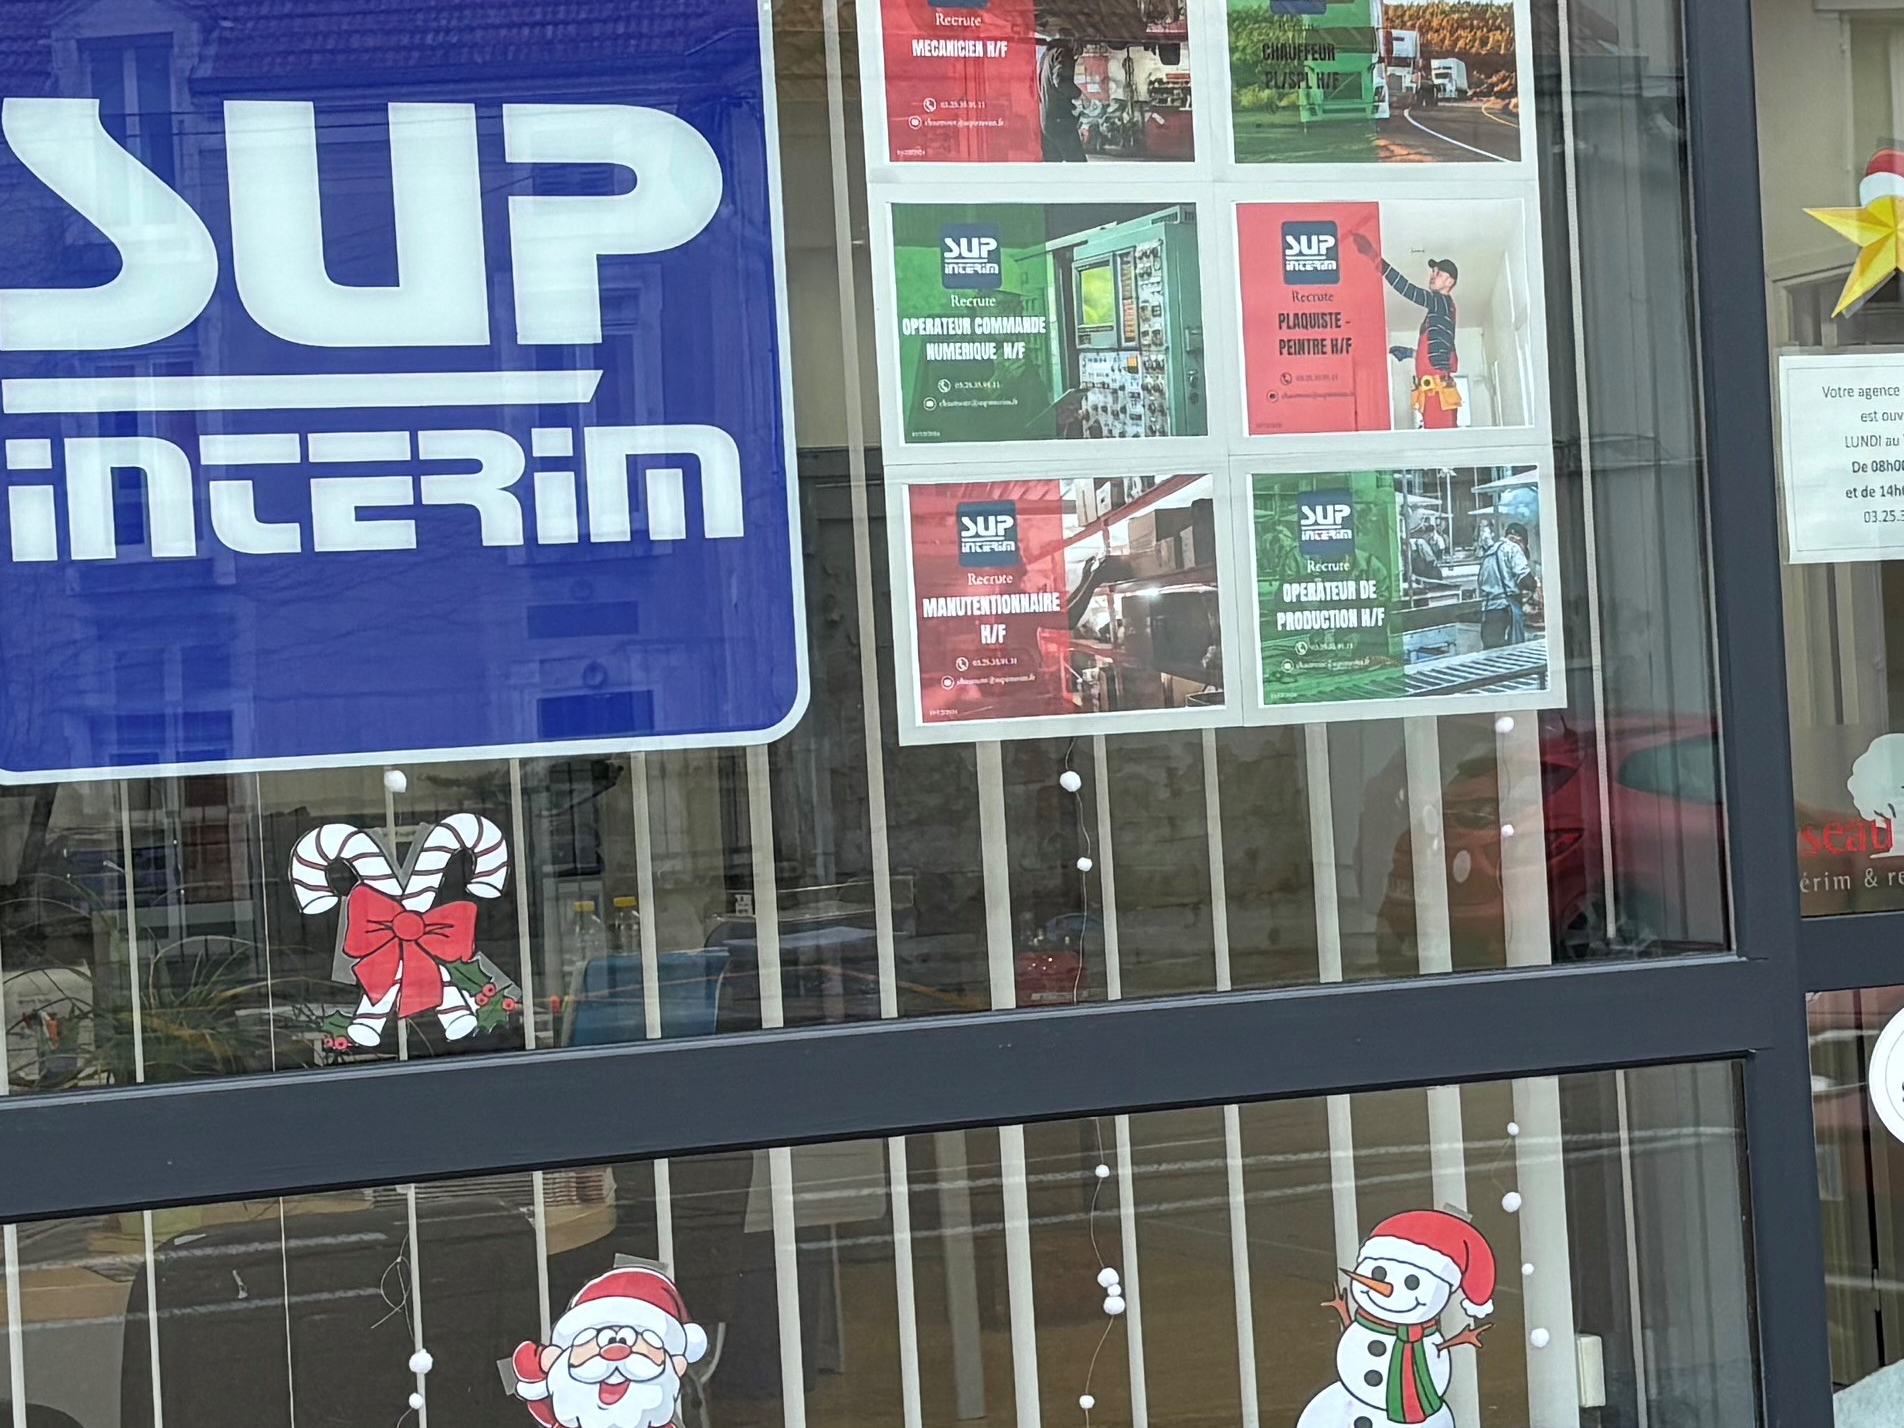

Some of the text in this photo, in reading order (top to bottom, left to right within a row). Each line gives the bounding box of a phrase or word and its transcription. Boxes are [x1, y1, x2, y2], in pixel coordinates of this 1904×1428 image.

[935, 13, 982, 26] Recrute
[912, 39, 1007, 57] MECANICIEN H/F
[1262, 42, 1336, 62] CHAUFFEUR
[1316, 72, 1340, 90] H/F
[944, 237, 998, 258] SUP
[1285, 235, 1336, 255] SUP
[951, 295, 996, 307] Recrute
[1292, 291, 1334, 303] Recrute
[902, 316, 1046, 335] OPERATEUR COMMANDE
[1278, 312, 1342, 330] PLAQUISTE
[926, 342, 1025, 360] NUMERIQUE H/F
[1279, 338, 1352, 356] PEINTRE H/F
[1821, 385, 1854, 399] Votre
[1858, 384, 1900, 400] agence
[1860, 410, 1878, 422] est
[1845, 435, 1881, 449] LUNDI
[1885, 437, 1900, 447] au
[1852, 460, 1868, 473] De
[1845, 487, 1859, 499] et
[1861, 484, 1876, 498] de
[1300, 504, 1351, 525] SUP
[961, 515, 1014, 537] SUP
[1307, 560, 1350, 572] Recrute
[968, 573, 1013, 585] Recrute
[1282, 580, 1377, 602] OPERATEUR DE
[923, 592, 1060, 618] MANUTENTIONNAIRE
[1277, 607, 1385, 631] PRODUCTION H/F
[981, 624, 1006, 644] H/F
[1864, 868, 1878, 888] &
